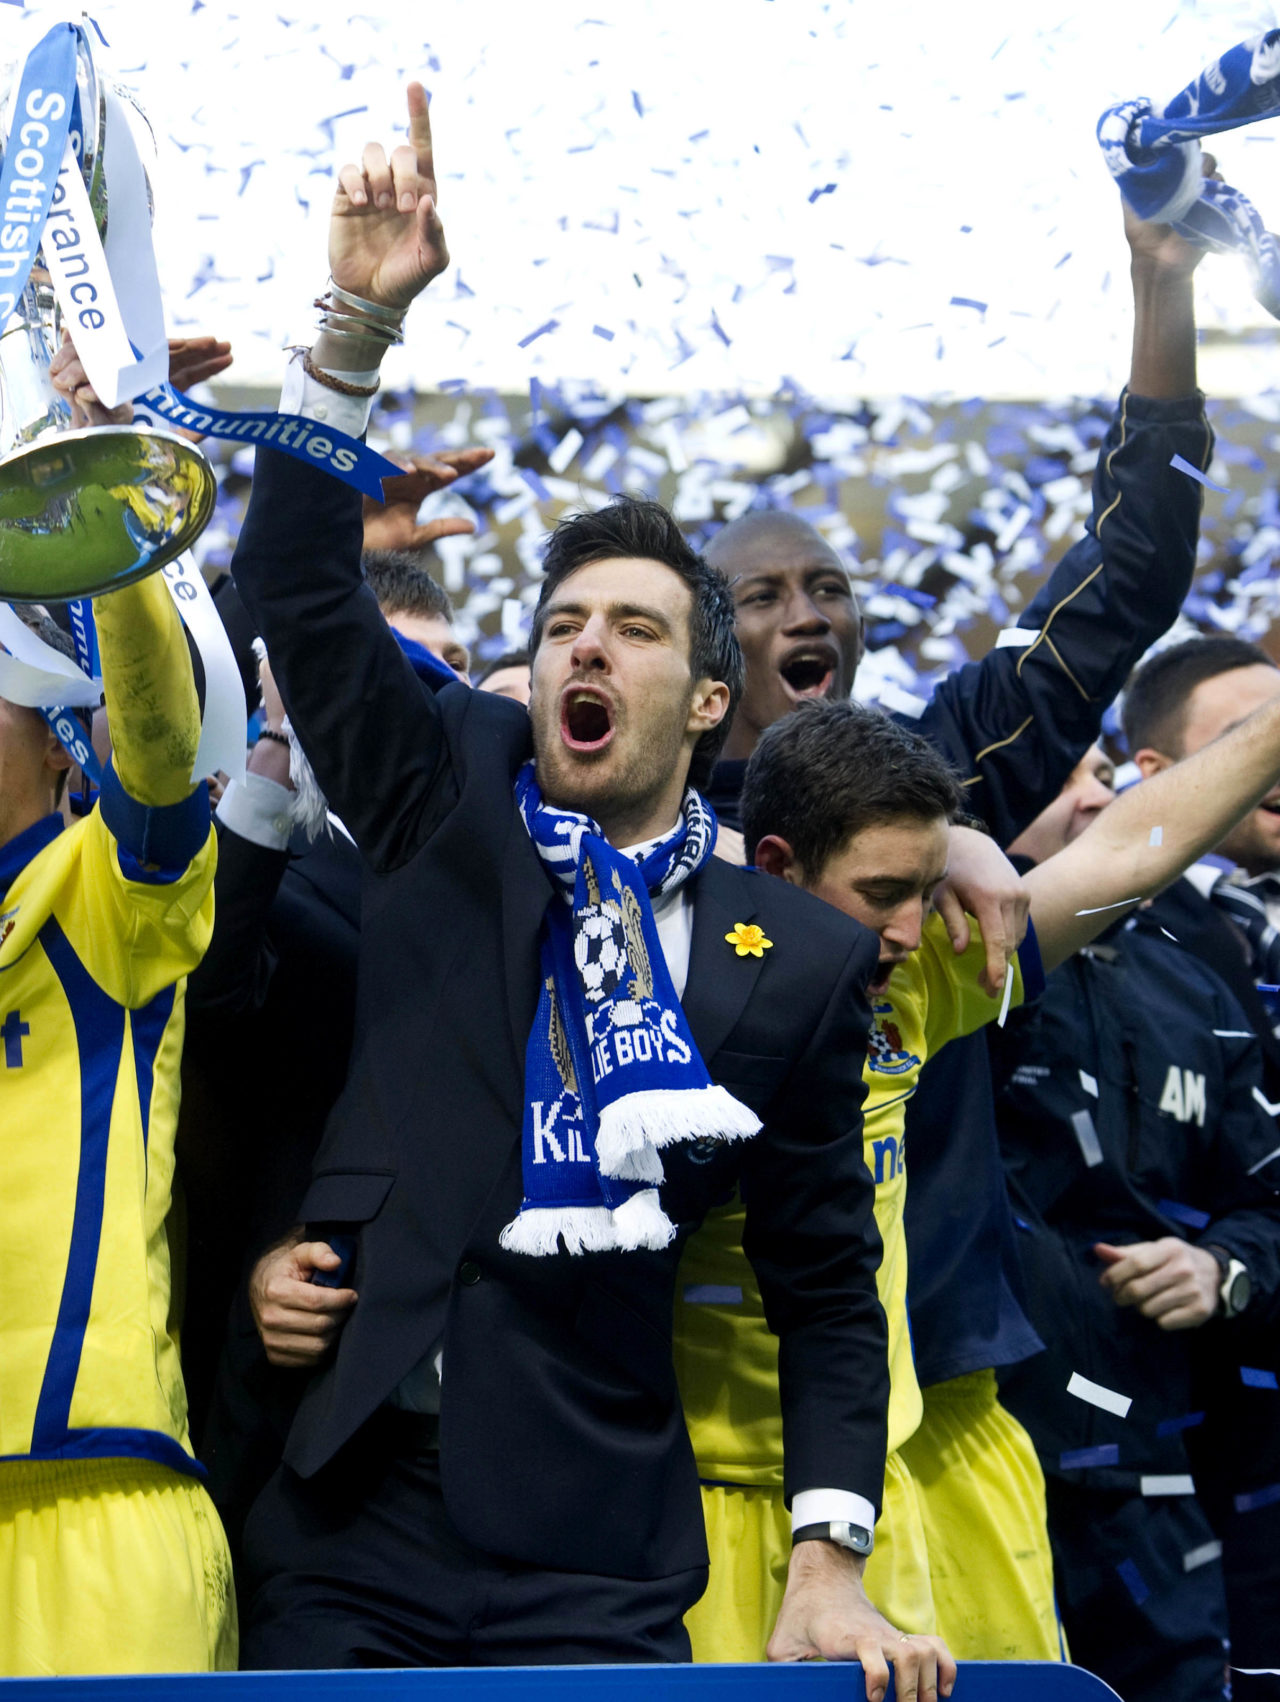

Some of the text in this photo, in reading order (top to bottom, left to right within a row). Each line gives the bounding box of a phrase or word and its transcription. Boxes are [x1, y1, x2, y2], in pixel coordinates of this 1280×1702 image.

[51, 168, 106, 331] erance
[591, 1008, 693, 1086] LIE BOYS
[1158, 1064, 1207, 1128] AM
[531, 1100, 592, 1165] KIL
